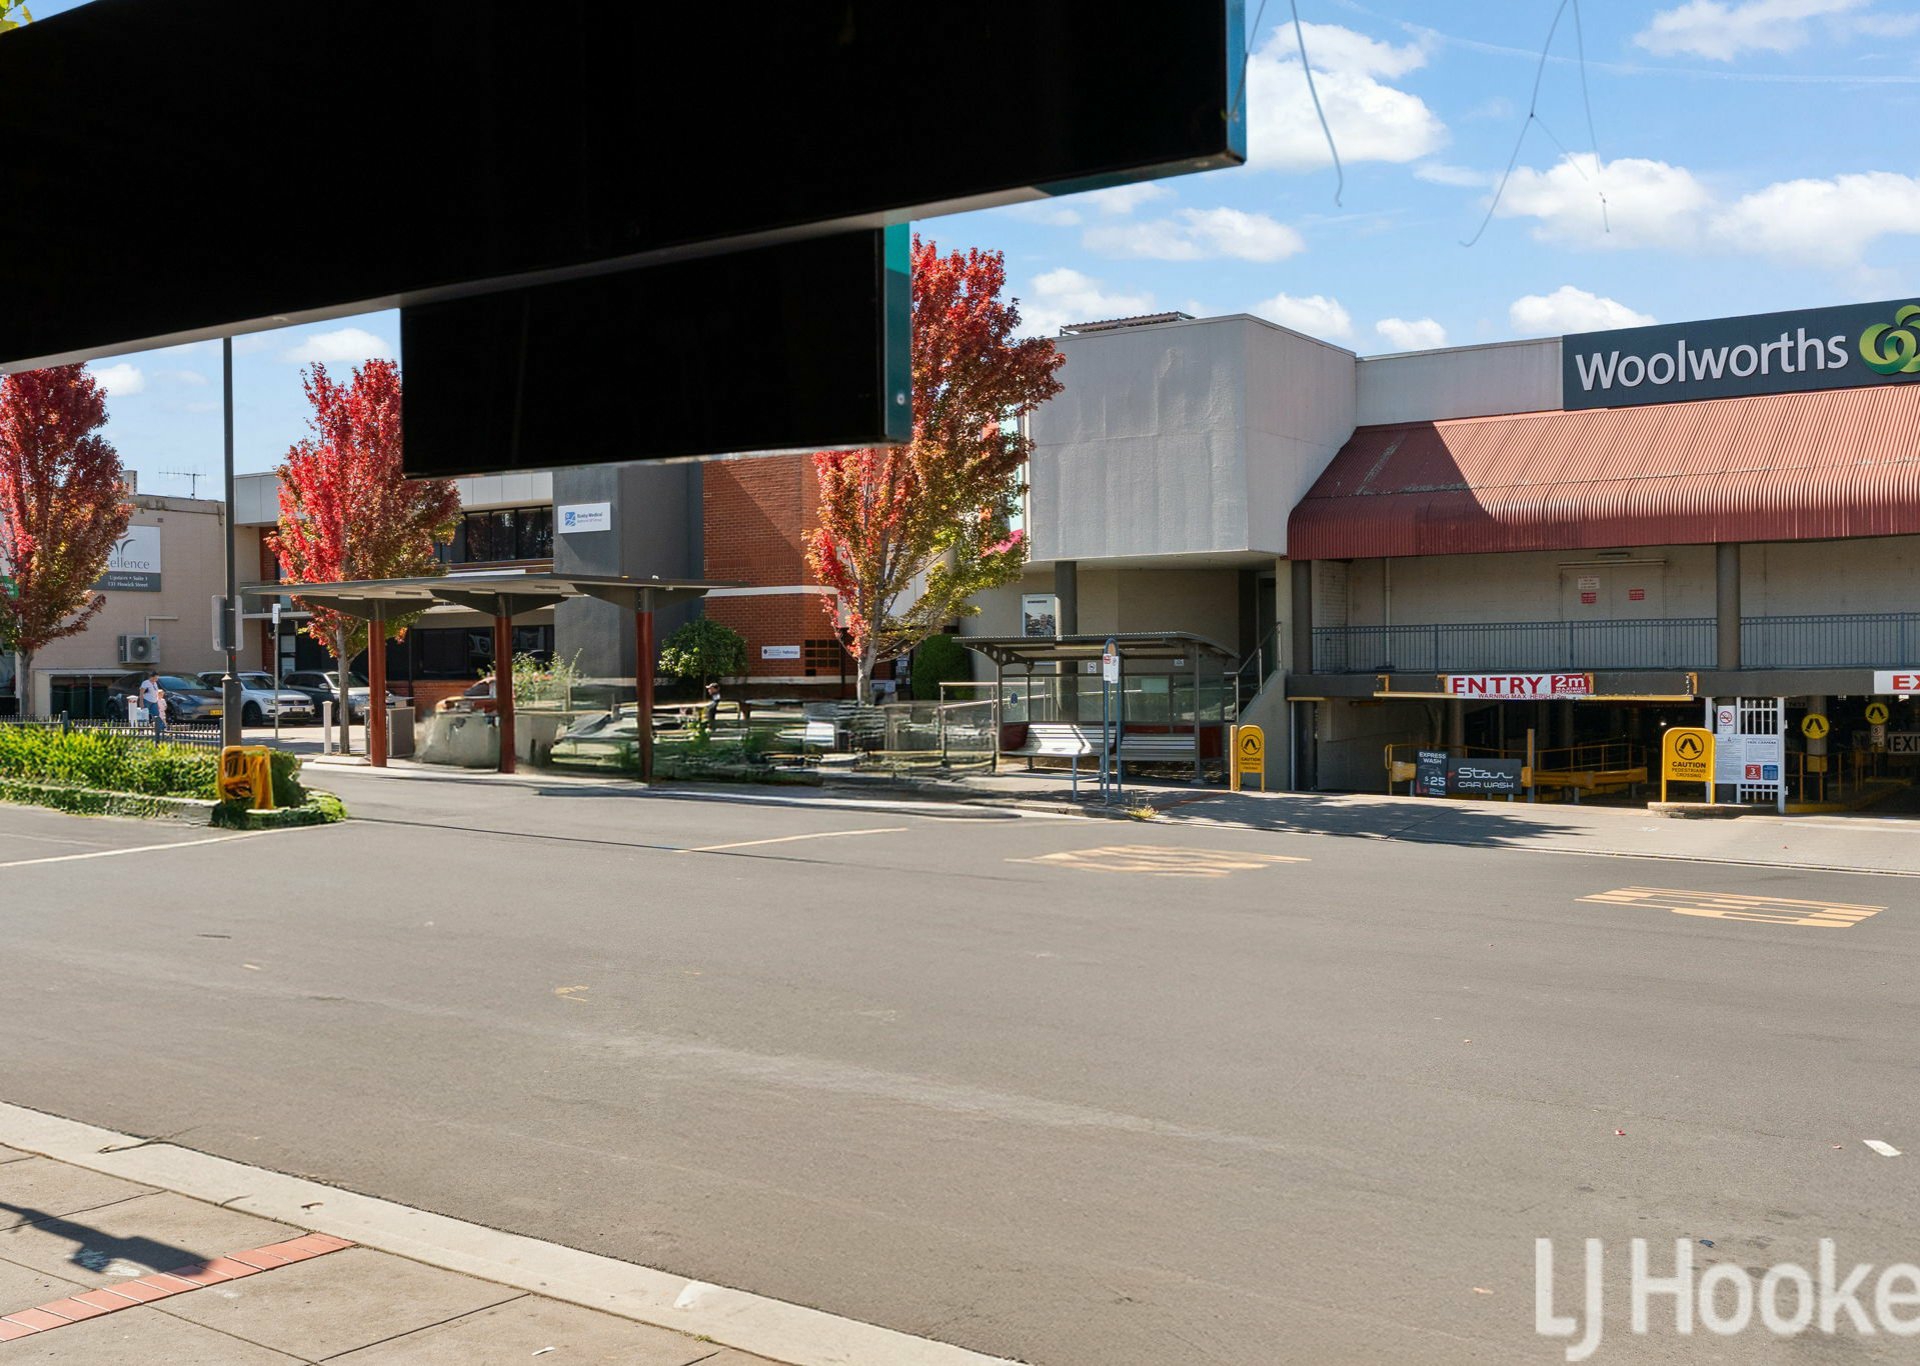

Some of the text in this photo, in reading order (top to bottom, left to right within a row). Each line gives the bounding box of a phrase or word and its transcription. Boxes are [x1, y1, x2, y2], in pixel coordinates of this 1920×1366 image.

[1575, 328, 1849, 391] Woolworths
[109, 556, 150, 570] ellence
[1453, 676, 1543, 694] ENTRY
[1555, 675, 1585, 687] 2m
[1894, 736, 1920, 752] EXI
[1672, 761, 1706, 769] CAUTION
[1750, 767, 1756, 775] 3
[1458, 767, 1513, 779] Star
